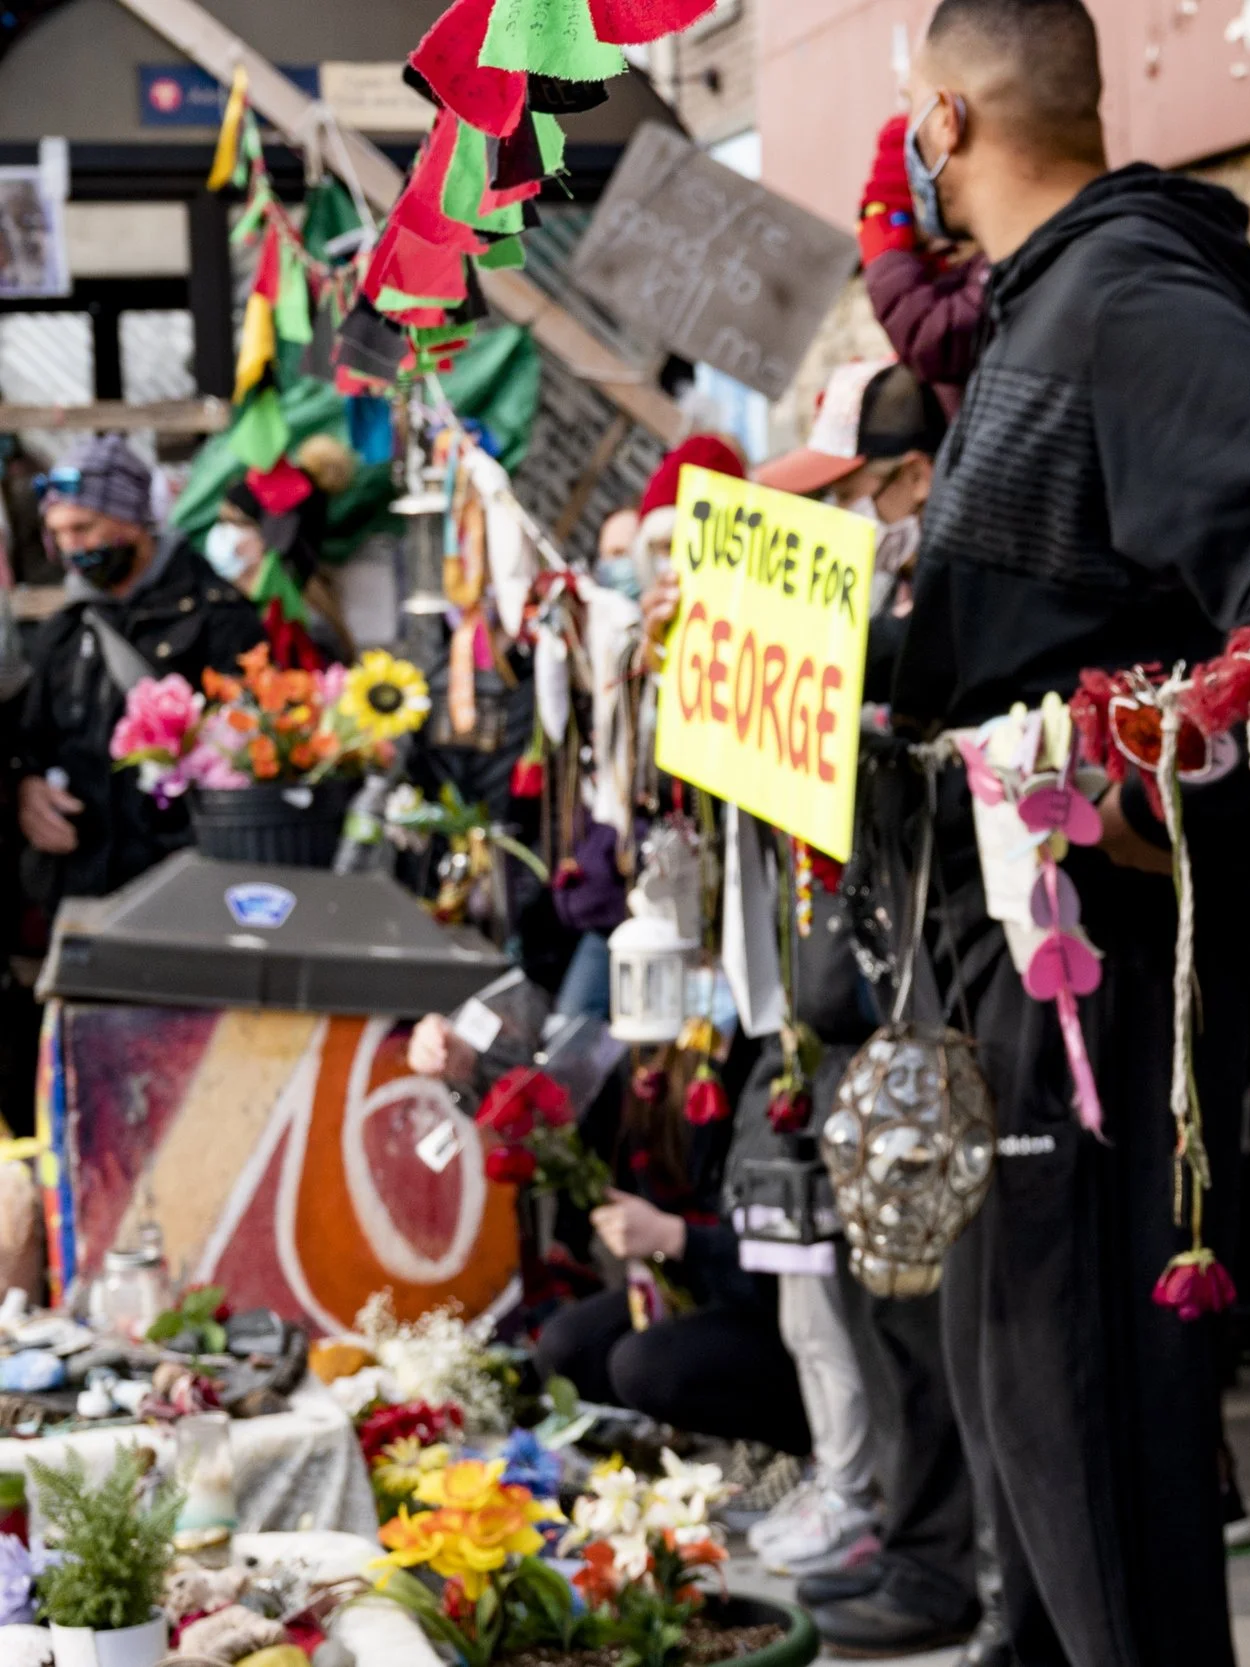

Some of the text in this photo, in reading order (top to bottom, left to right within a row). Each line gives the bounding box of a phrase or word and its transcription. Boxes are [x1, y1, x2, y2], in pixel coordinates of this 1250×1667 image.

[688, 500, 858, 626] JUSTICE FOR
[677, 601, 844, 784] GEORGE
